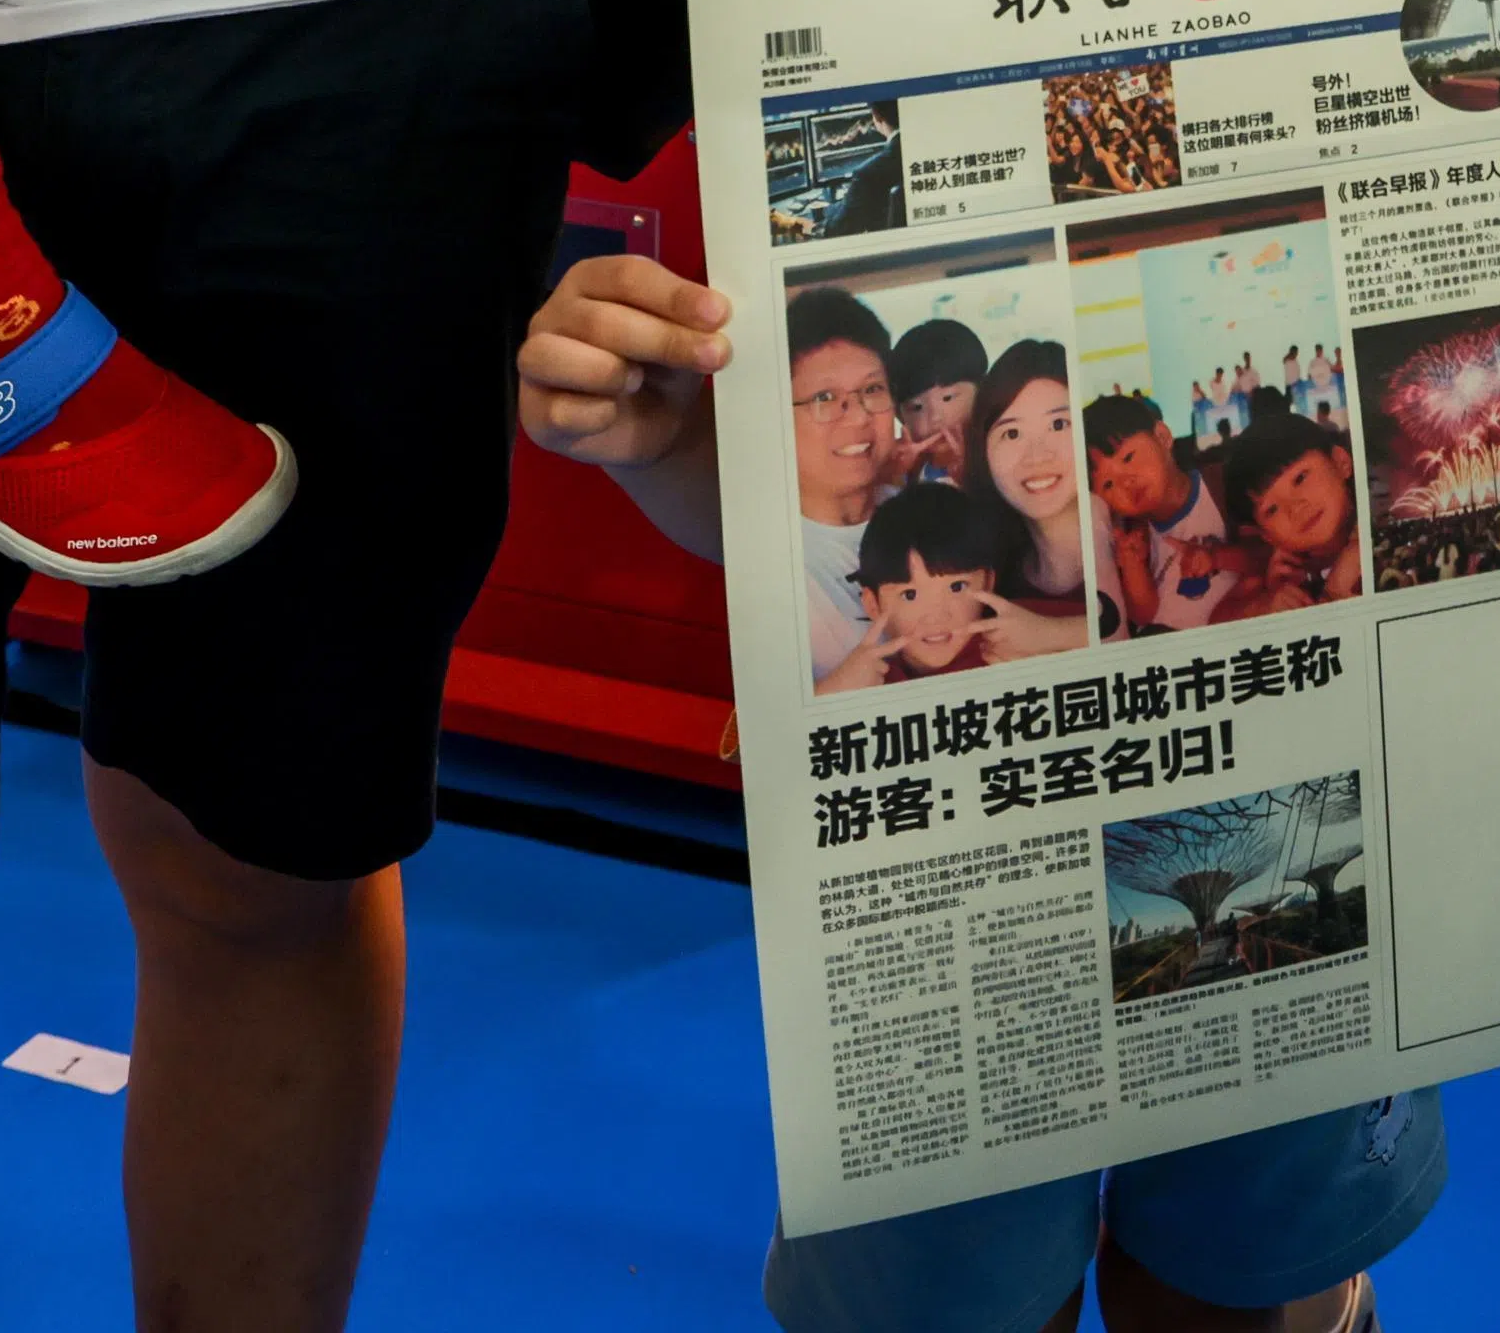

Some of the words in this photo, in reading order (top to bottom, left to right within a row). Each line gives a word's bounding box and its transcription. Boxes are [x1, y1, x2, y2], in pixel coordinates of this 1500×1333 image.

[1080, 23, 1159, 47] LIANHE
[1171, 11, 1252, 35] ZAOBAO
[1312, 73, 1352, 93] 号外！
[1314, 84, 1411, 114] 巨星横空出世
[1181, 111, 1275, 138] 横扫各大排行榜
[1316, 106, 1421, 136] 粉丝挤爆机场！
[1350, 143, 1359, 155] 2
[1230, 161, 1238, 172] 7
[958, 202, 967, 214] 5
[67, 537, 96, 550] new
[97, 534, 158, 550] balance
[808, 634, 1344, 781] 新加坡花园城市美称
